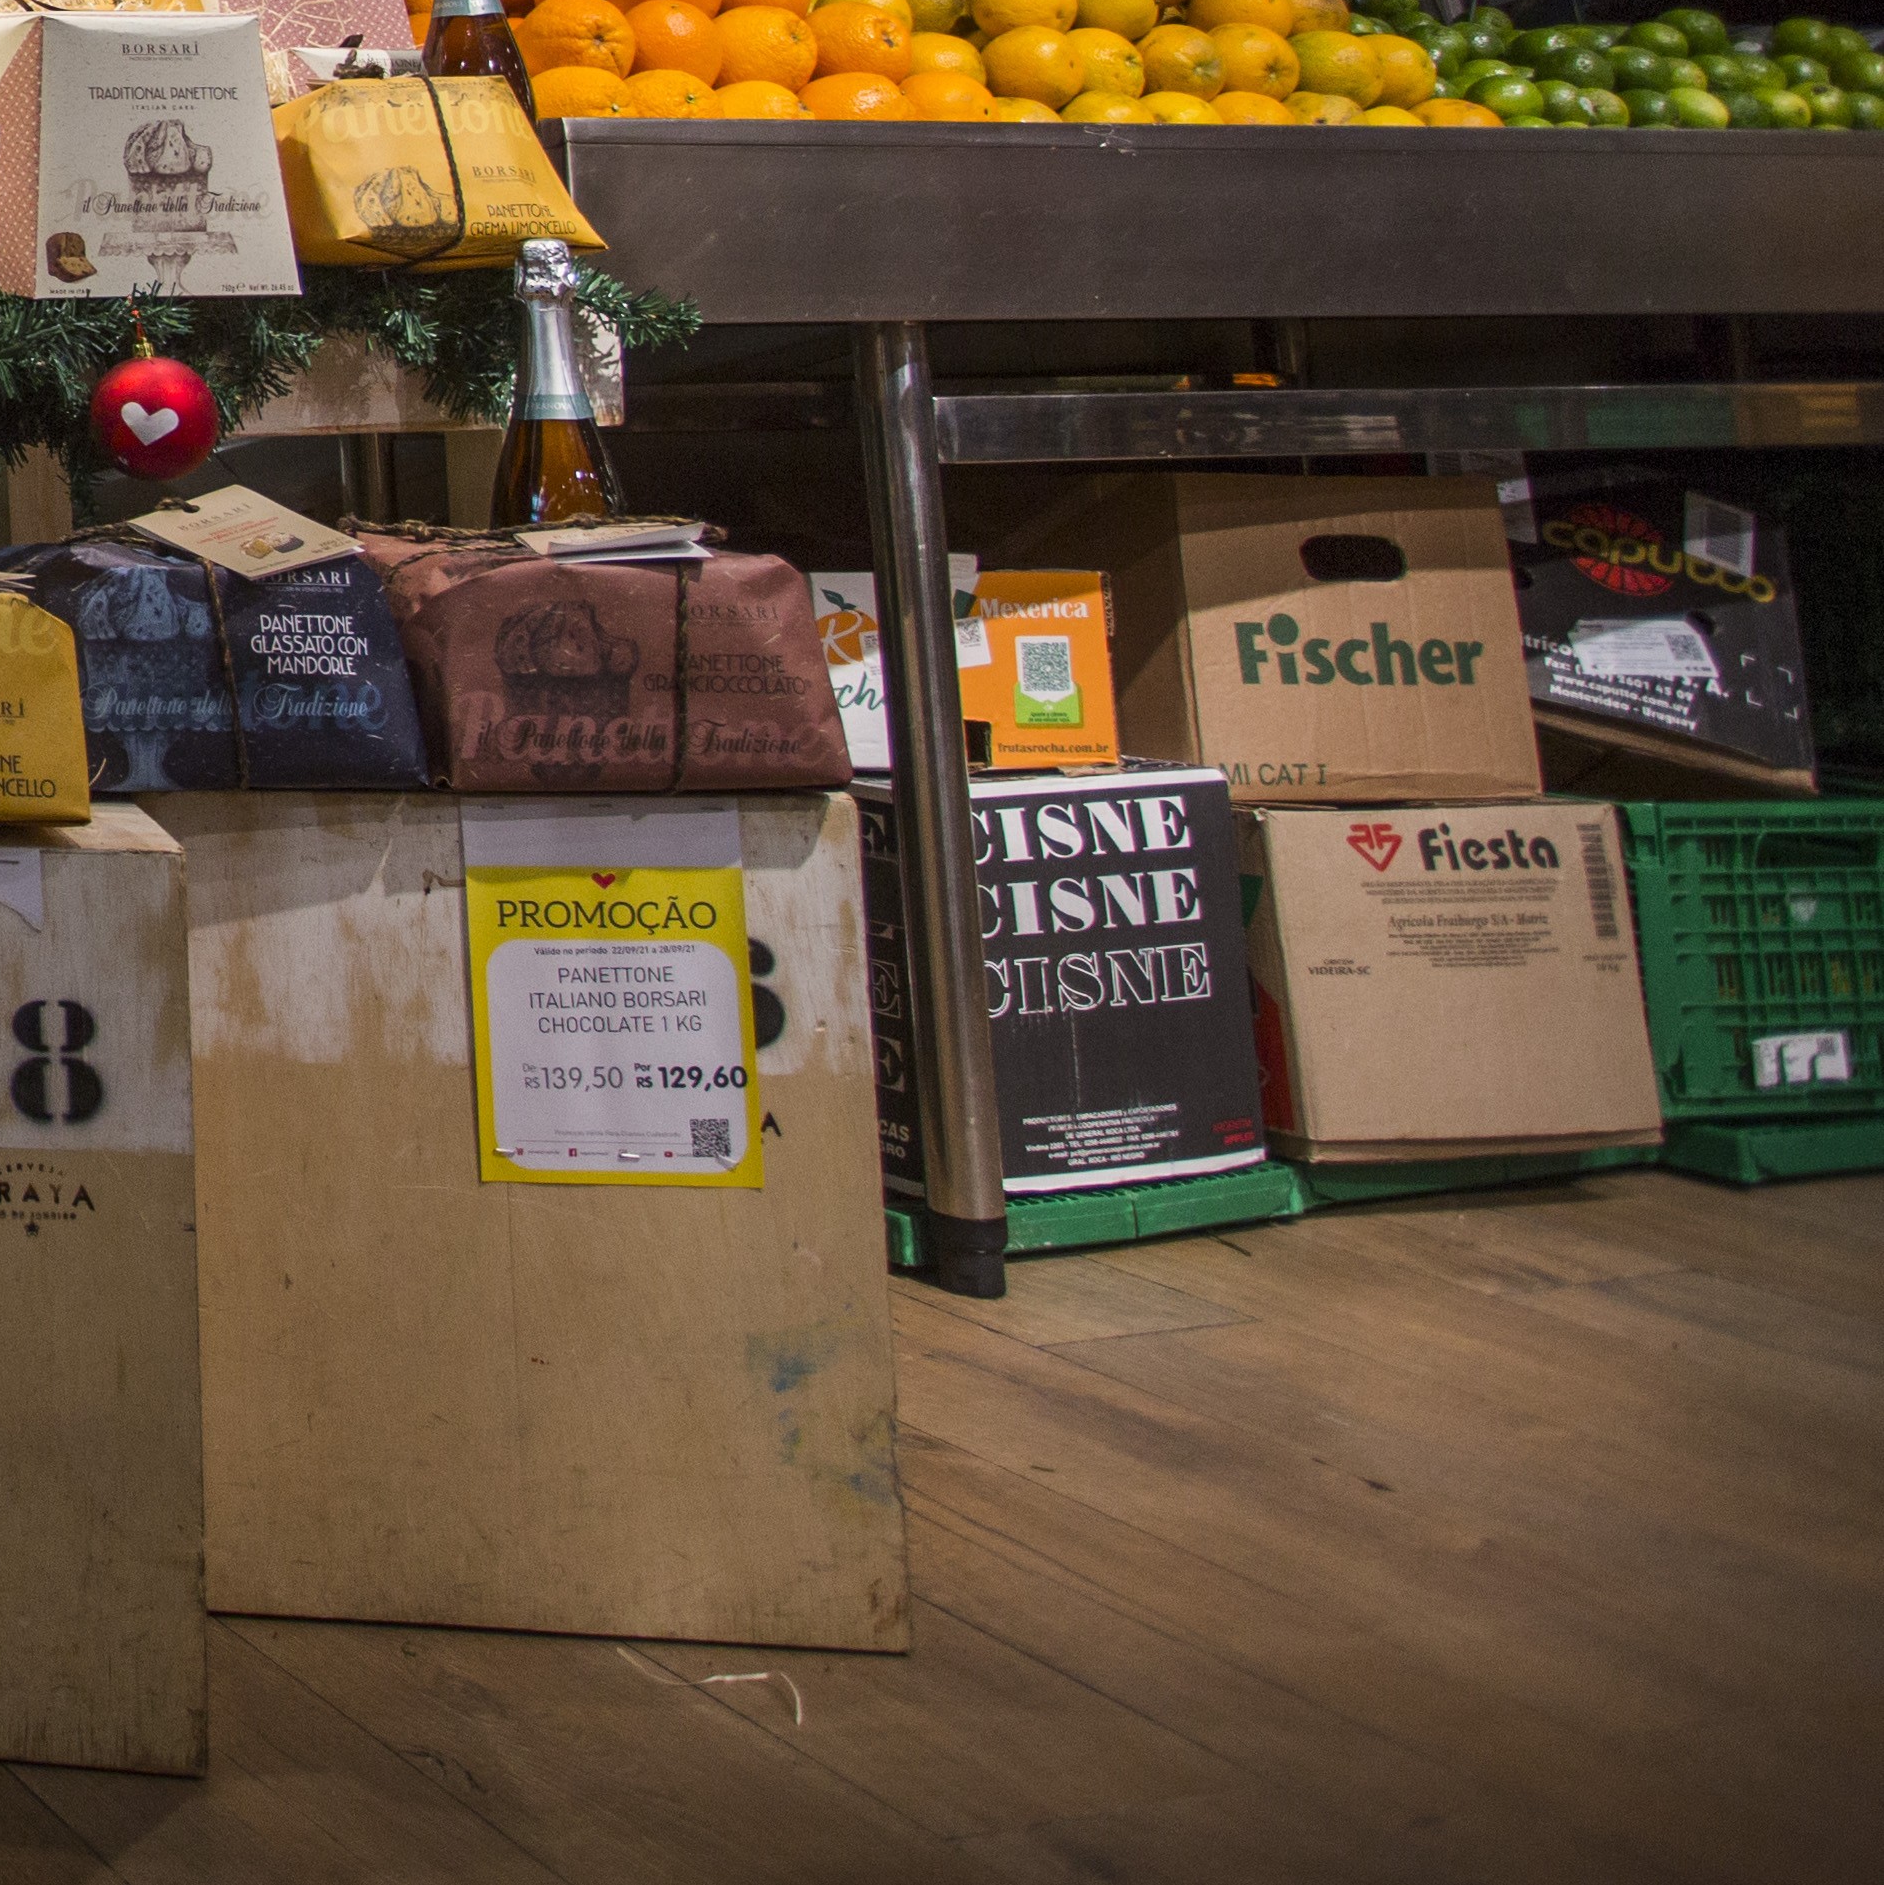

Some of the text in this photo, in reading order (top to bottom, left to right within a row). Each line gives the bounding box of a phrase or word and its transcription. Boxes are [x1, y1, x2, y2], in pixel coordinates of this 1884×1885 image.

[88, 86, 238, 101] TRADITIONAL PANETTONE
[469, 219, 577, 236] CREMA LIMONCELLO
[980, 597, 1090, 619] Mexerica
[260, 615, 354, 634] PANETTONE
[251, 635, 368, 655] GLASSATO CON
[1233, 613, 1484, 687] Fischer
[267, 657, 357, 675] MANDORLE
[1549, 685, 1696, 731] Montevideo Uruguay
[998, 743, 1109, 753] frutasrocha.com.br
[1257, 764, 1308, 786] CAT
[1416, 822, 1560, 871] Fiesta
[496, 896, 717, 934] PROMOÇÃO
[534, 946, 649, 956] Válido 22/09/21
[558, 967, 675, 983] PANETTONE
[1308, 966, 1371, 975] VIDEIRA-SC
[529, 991, 707, 1009] ITALIANO BORSARI
[538, 1015, 702, 1034] CHOCOLATE 1 KG
[541, 1066, 748, 1092] 139,50 129,60
